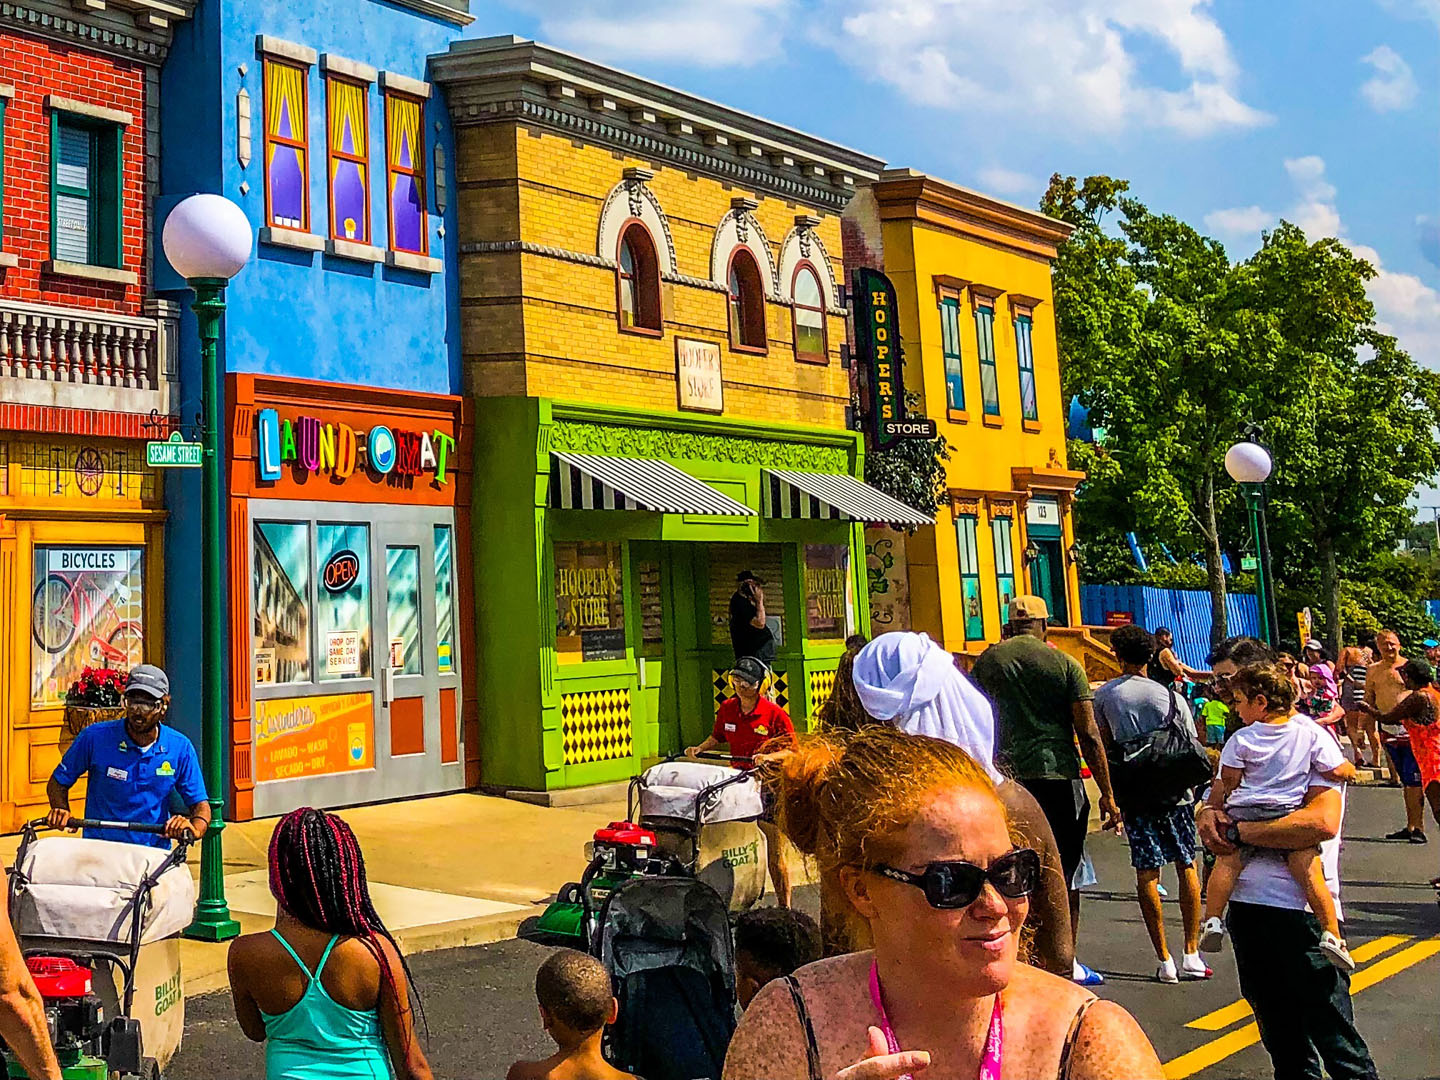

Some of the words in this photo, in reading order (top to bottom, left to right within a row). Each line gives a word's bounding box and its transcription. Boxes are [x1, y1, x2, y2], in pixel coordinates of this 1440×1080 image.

[871, 292, 893, 419] HOOPER'S
[886, 423, 930, 434] STORE
[150, 445, 176, 463] SESAME
[177, 445, 200, 463] STREET
[1037, 505, 1047, 518] 123
[62, 552, 115, 569] BICYCLES
[326, 559, 356, 585] OPEN
[571, 598, 609, 626] STORE
[329, 637, 343, 646] DROP
[346, 637, 356, 646] OFF
[329, 647, 343, 656] SAME
[346, 647, 356, 656] DAY
[329, 657, 356, 665] SERVICE
[307, 739, 328, 753] WASH
[275, 761, 304, 778] SECADO
[311, 756, 326, 770] DRY
[722, 845, 748, 859] BILLY
[722, 855, 749, 868] GOAT
[155, 975, 176, 1001] BILLY
[155, 989, 176, 1016] GOAT
